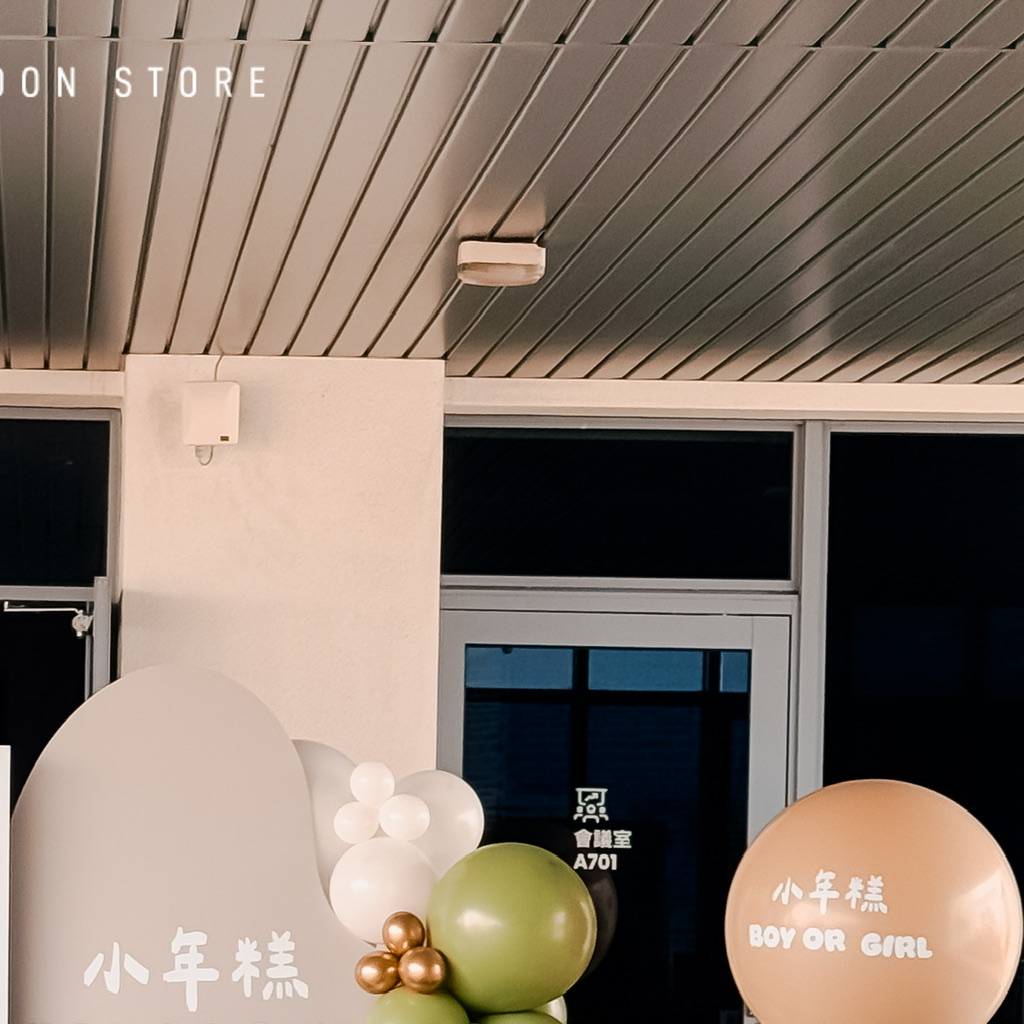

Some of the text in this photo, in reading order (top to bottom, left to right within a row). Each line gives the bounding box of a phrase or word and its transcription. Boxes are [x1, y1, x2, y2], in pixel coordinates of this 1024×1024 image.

[574, 829, 632, 849] 會議室
[573, 853, 617, 870] A701
[772, 869, 888, 914] 小年糕
[749, 924, 933, 959] BOY OR GIRL
[83, 926, 309, 1012] 小年糕
